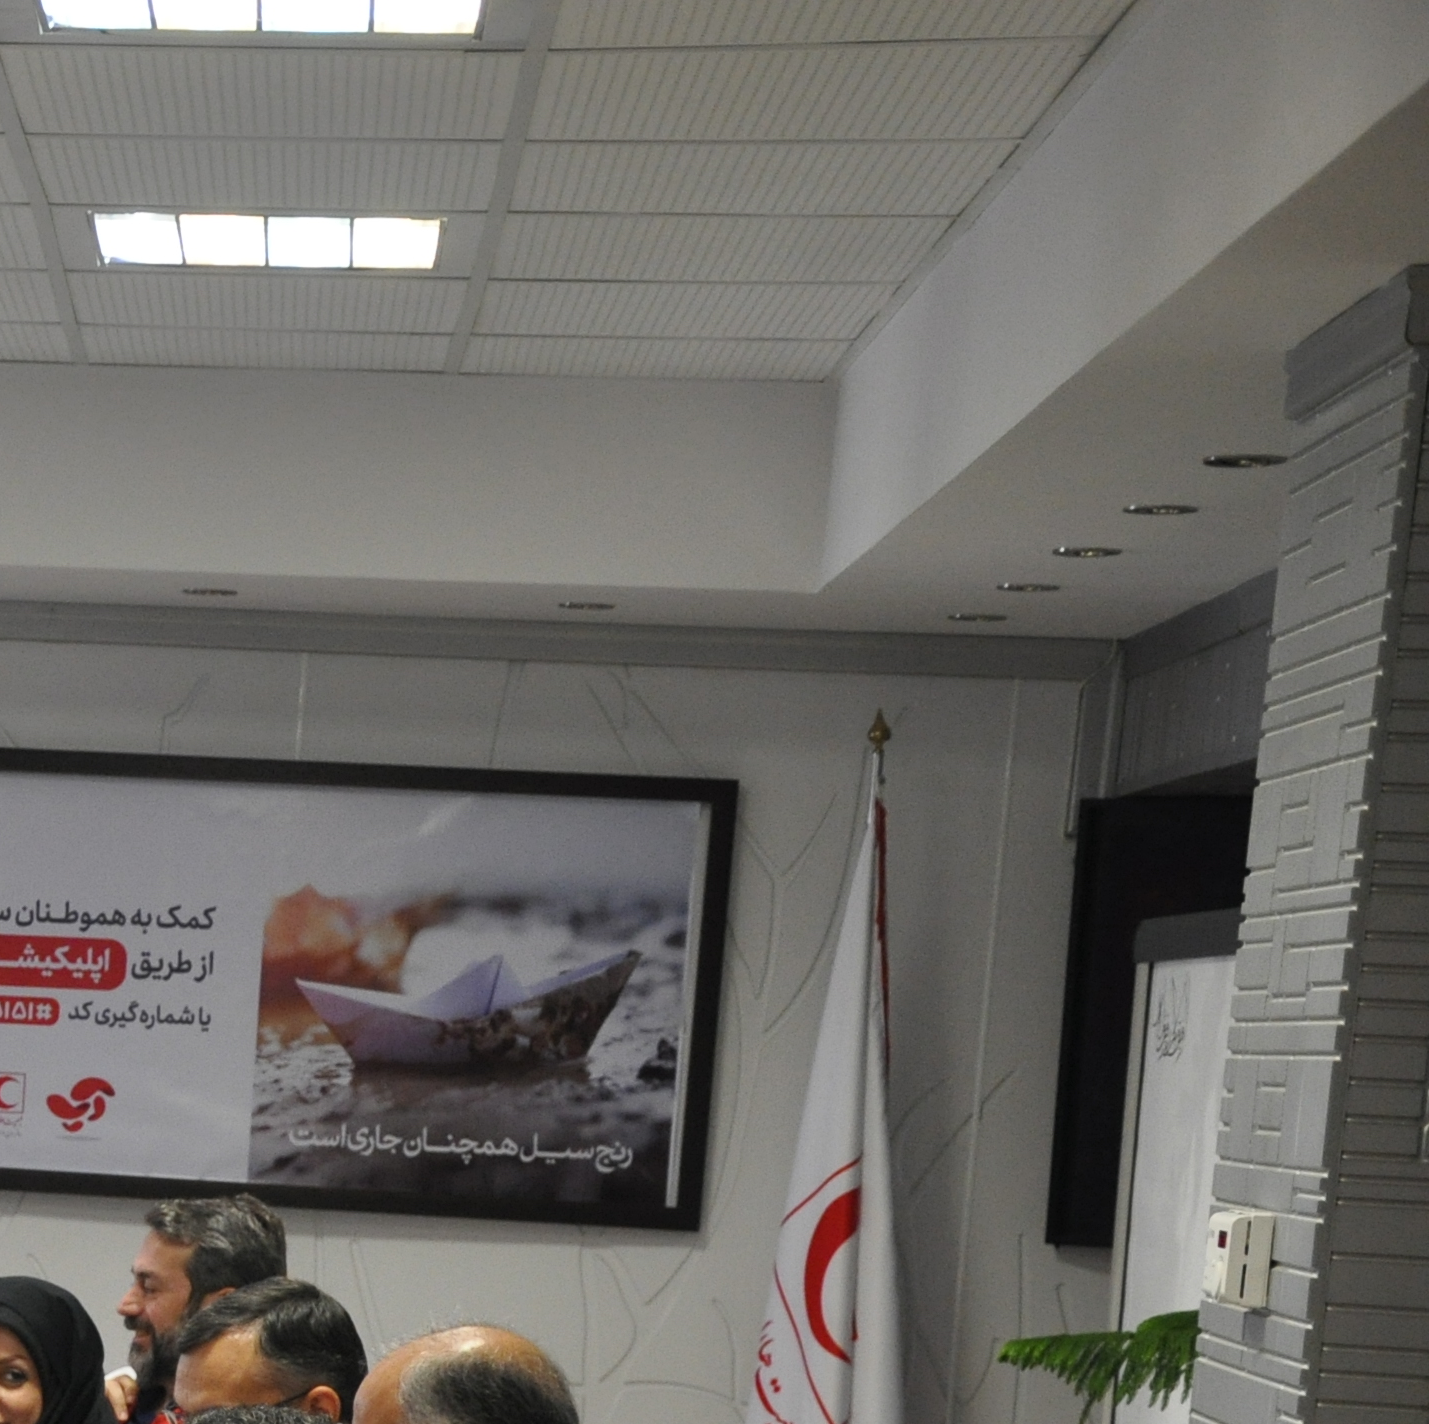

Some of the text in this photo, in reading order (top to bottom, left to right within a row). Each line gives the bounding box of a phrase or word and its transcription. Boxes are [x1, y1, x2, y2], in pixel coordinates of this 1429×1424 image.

[15, 900, 126, 932] هموطنان
[130, 909, 152, 934] به
[156, 905, 216, 929] کمک
[131, 950, 192, 980] طریق
[194, 950, 214, 981] از
[68, 1002, 94, 1020] کد
[289, 1123, 633, 1173] رنج سیل همچنان جاری است
